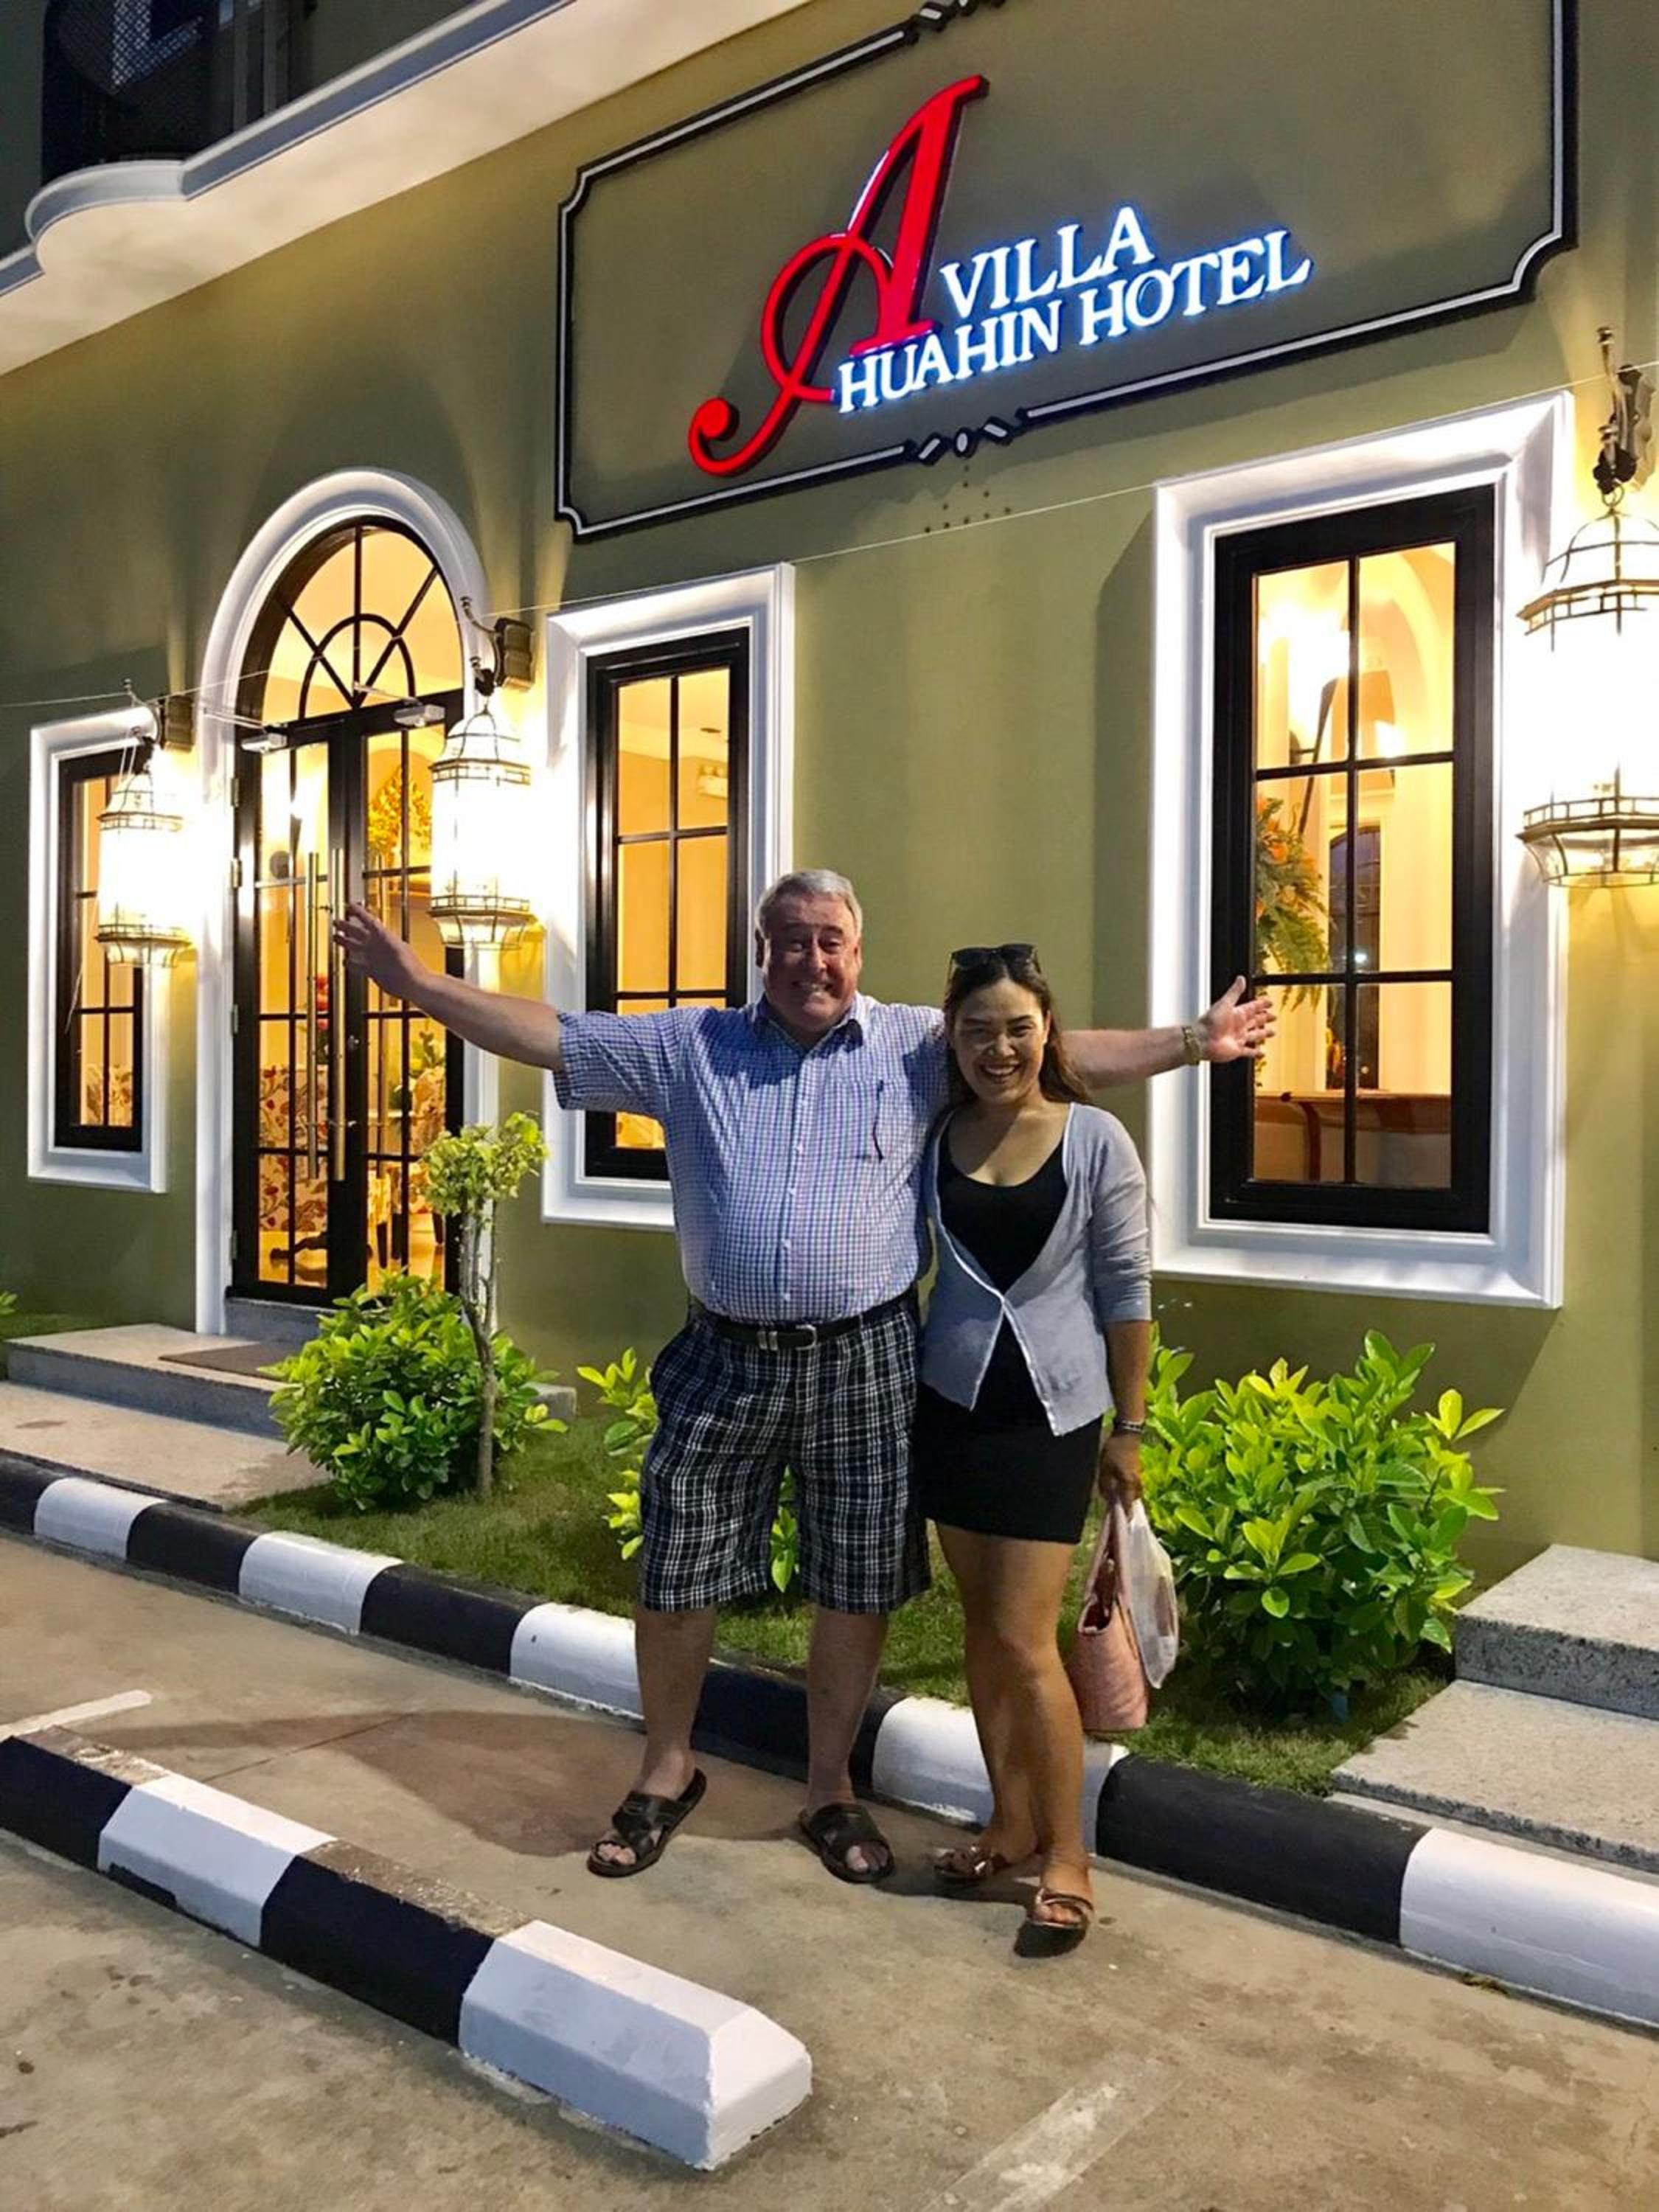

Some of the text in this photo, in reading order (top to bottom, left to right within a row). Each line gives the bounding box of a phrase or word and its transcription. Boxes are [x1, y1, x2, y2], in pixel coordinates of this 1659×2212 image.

[688, 74, 1155, 476] A VILLA
[838, 229, 1312, 414] HUAHIN HOTEL
